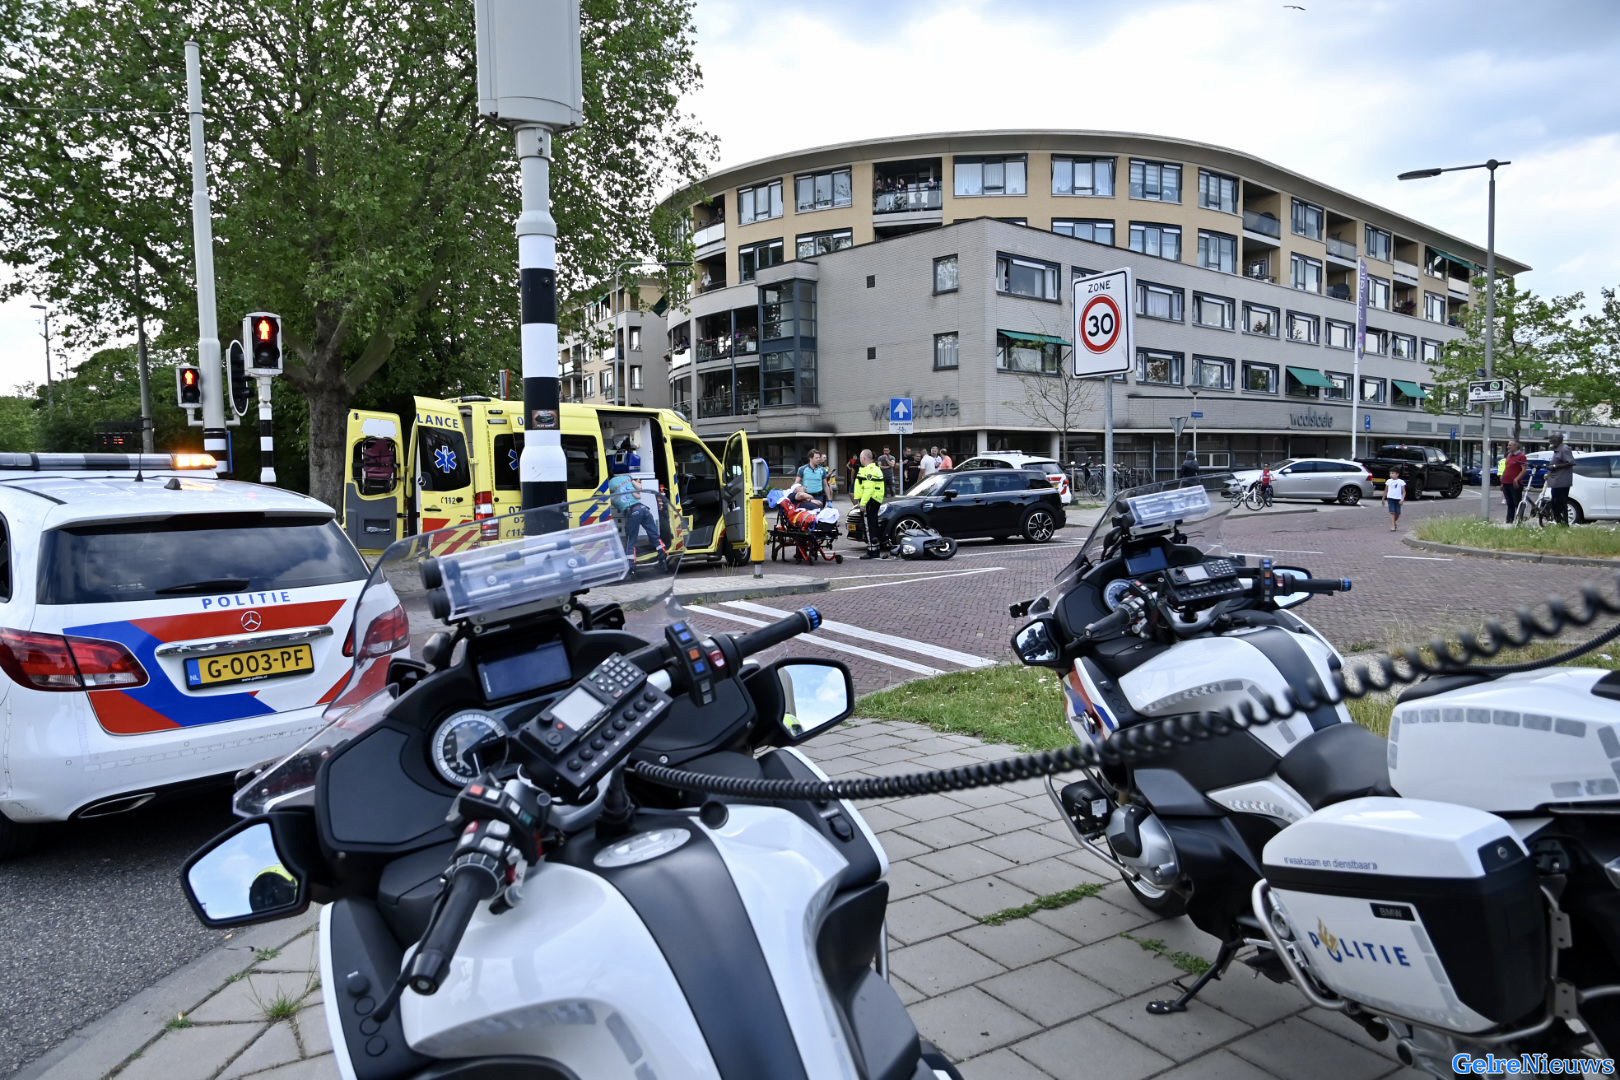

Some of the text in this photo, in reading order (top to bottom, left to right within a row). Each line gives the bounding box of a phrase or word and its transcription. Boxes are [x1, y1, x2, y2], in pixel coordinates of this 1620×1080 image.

[1088, 280, 1111, 293] ZONE
[1088, 313, 1114, 337] 30
[416, 413, 459, 428] LANCE
[444, 496, 456, 505] 112
[201, 591, 291, 609] POLITIE
[207, 648, 304, 679] G-003-PF
[1308, 931, 1411, 967] POLITIE
